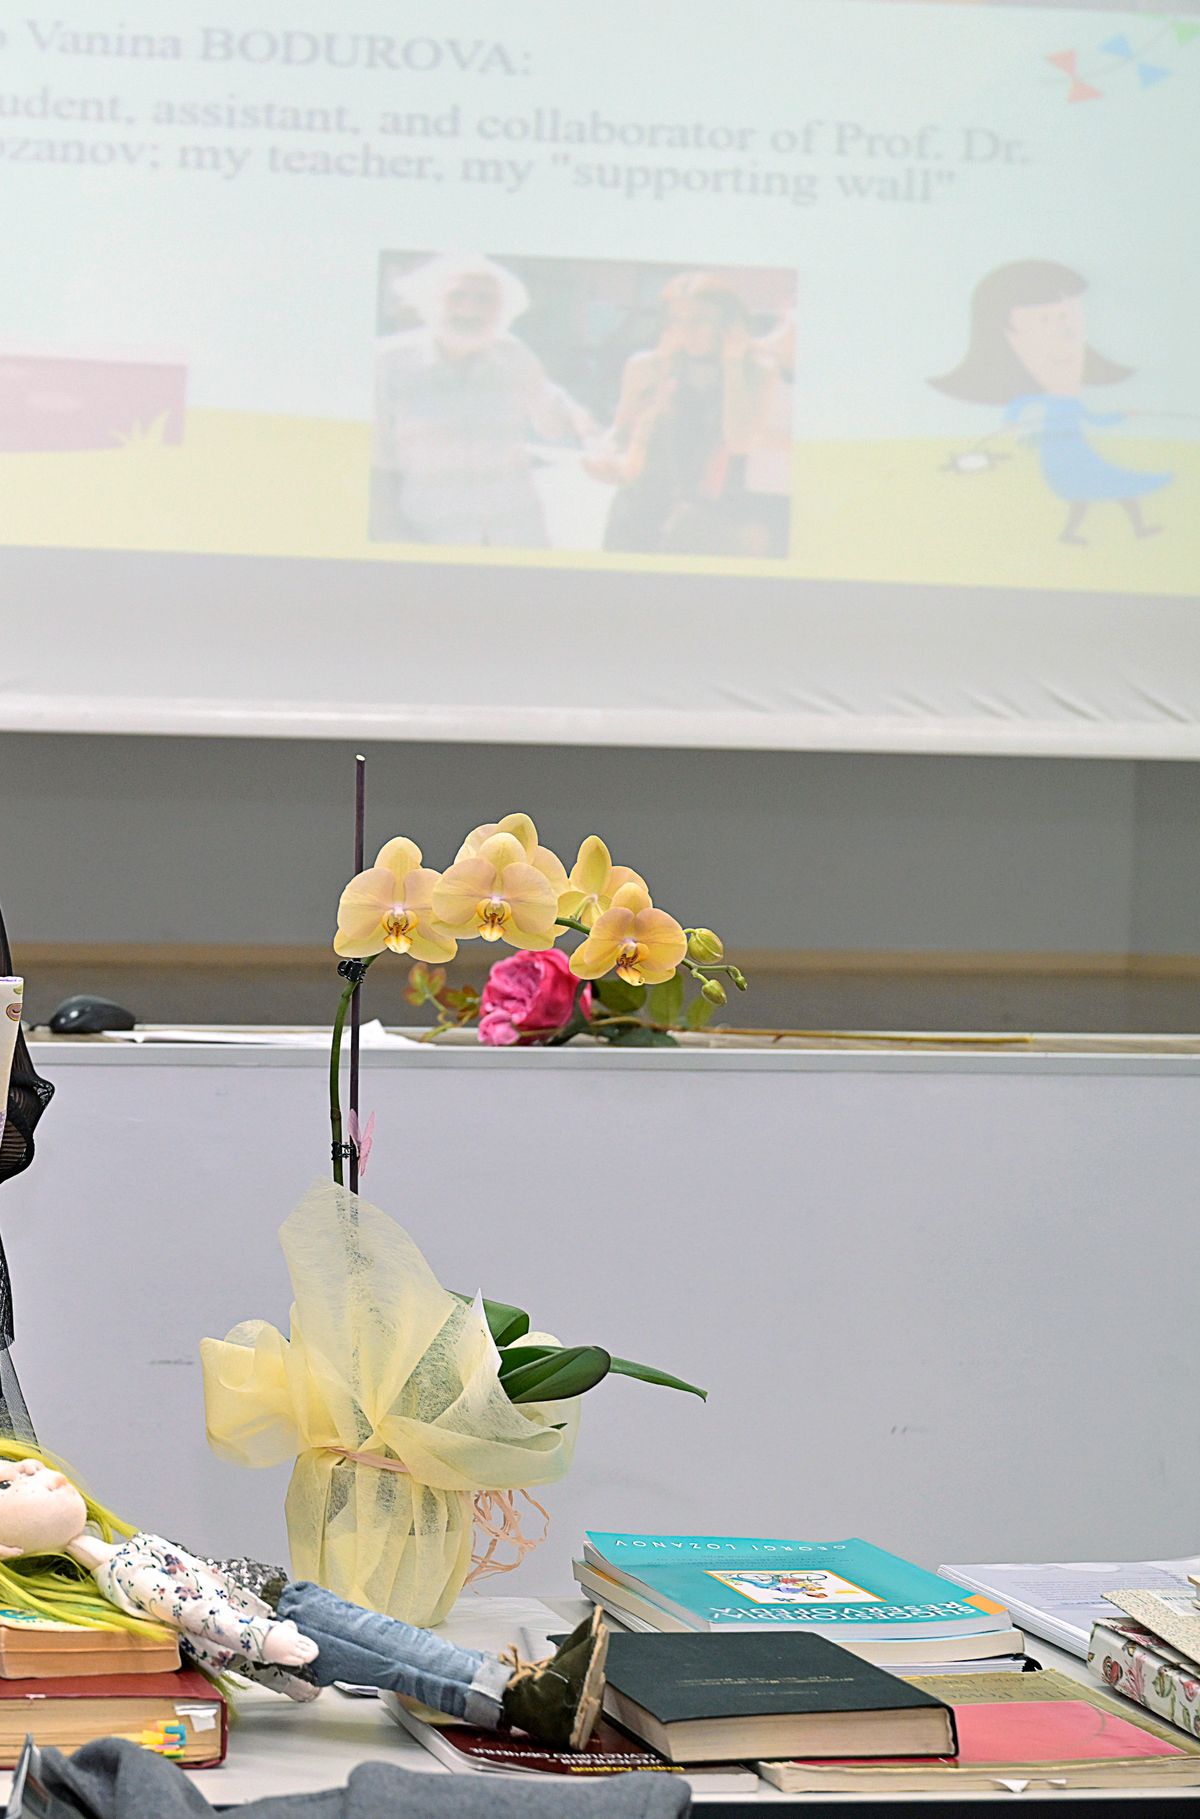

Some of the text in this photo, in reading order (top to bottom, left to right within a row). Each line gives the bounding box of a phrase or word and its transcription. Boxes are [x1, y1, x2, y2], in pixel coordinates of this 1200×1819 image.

[26, 18, 182, 61] Vanina
[200, 26, 532, 77] BODUROVA:
[379, 104, 461, 140] and
[476, 107, 759, 154] collaborator
[770, 119, 825, 157] of
[835, 121, 944, 163] Prof.
[960, 127, 1032, 167] Dr.
[177, 140, 252, 181] my
[460, 155, 534, 195] my
[550, 152, 819, 207] "supporting
[835, 164, 957, 205] wall"
[615, 1540, 846, 1552] GEORGI LOZANOV
